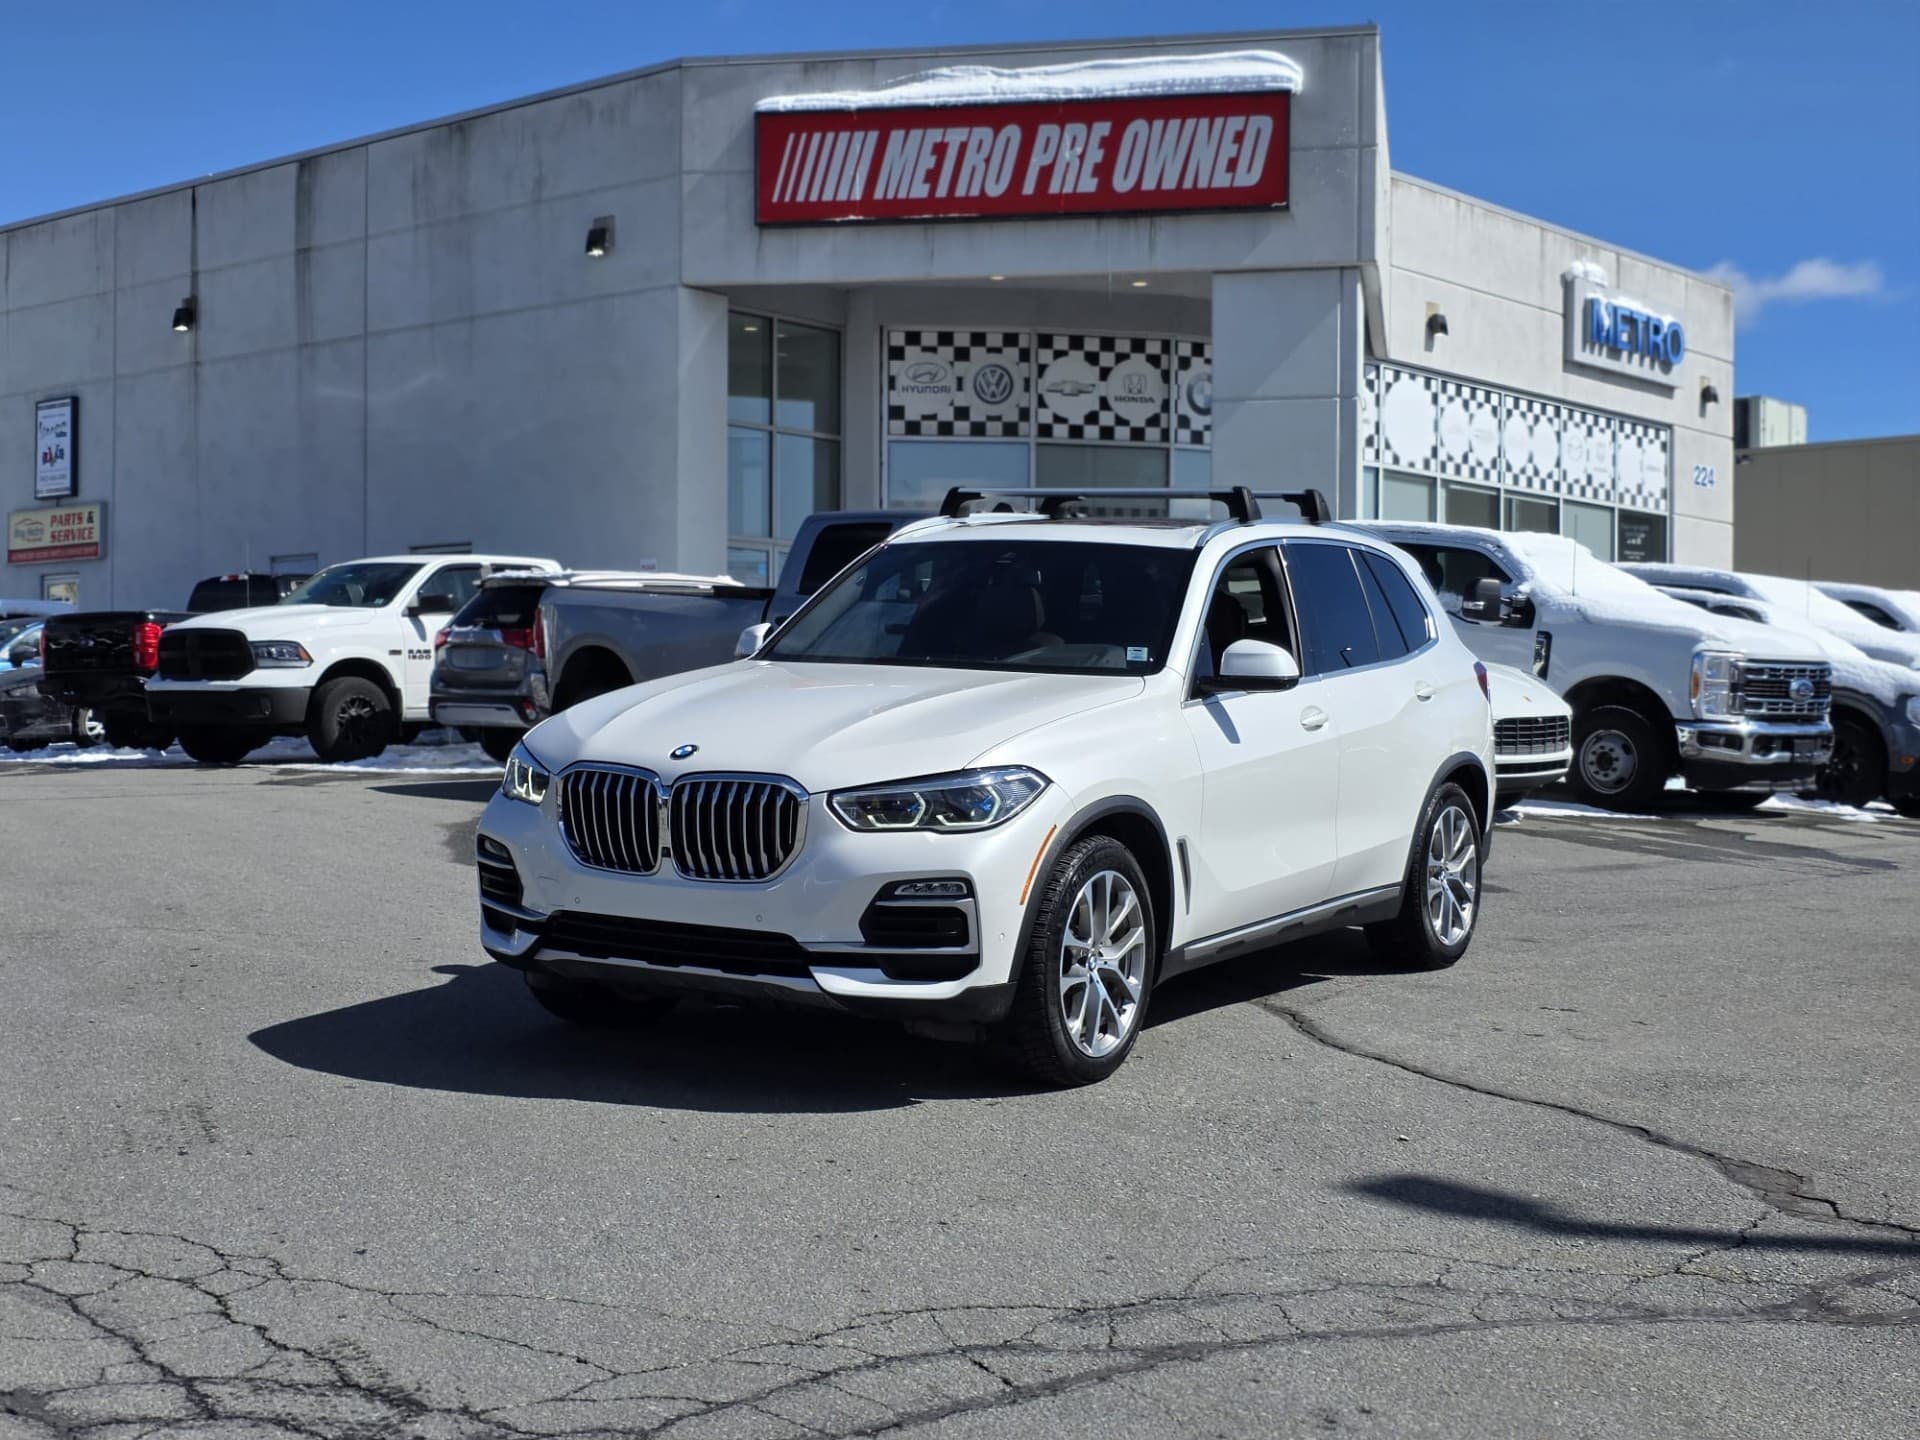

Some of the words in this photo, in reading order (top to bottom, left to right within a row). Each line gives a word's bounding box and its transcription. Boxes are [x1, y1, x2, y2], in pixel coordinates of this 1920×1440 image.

[874, 124, 1021, 200] METRO
[1022, 121, 1112, 196] PRE
[1112, 115, 1273, 193] OWNED
[1591, 298, 1685, 365] METRO
[902, 384, 951, 394] HYUNDAI
[1694, 465, 1715, 487] 224
[50, 512, 83, 528] PARTS
[50, 527, 94, 543] SERVICE
